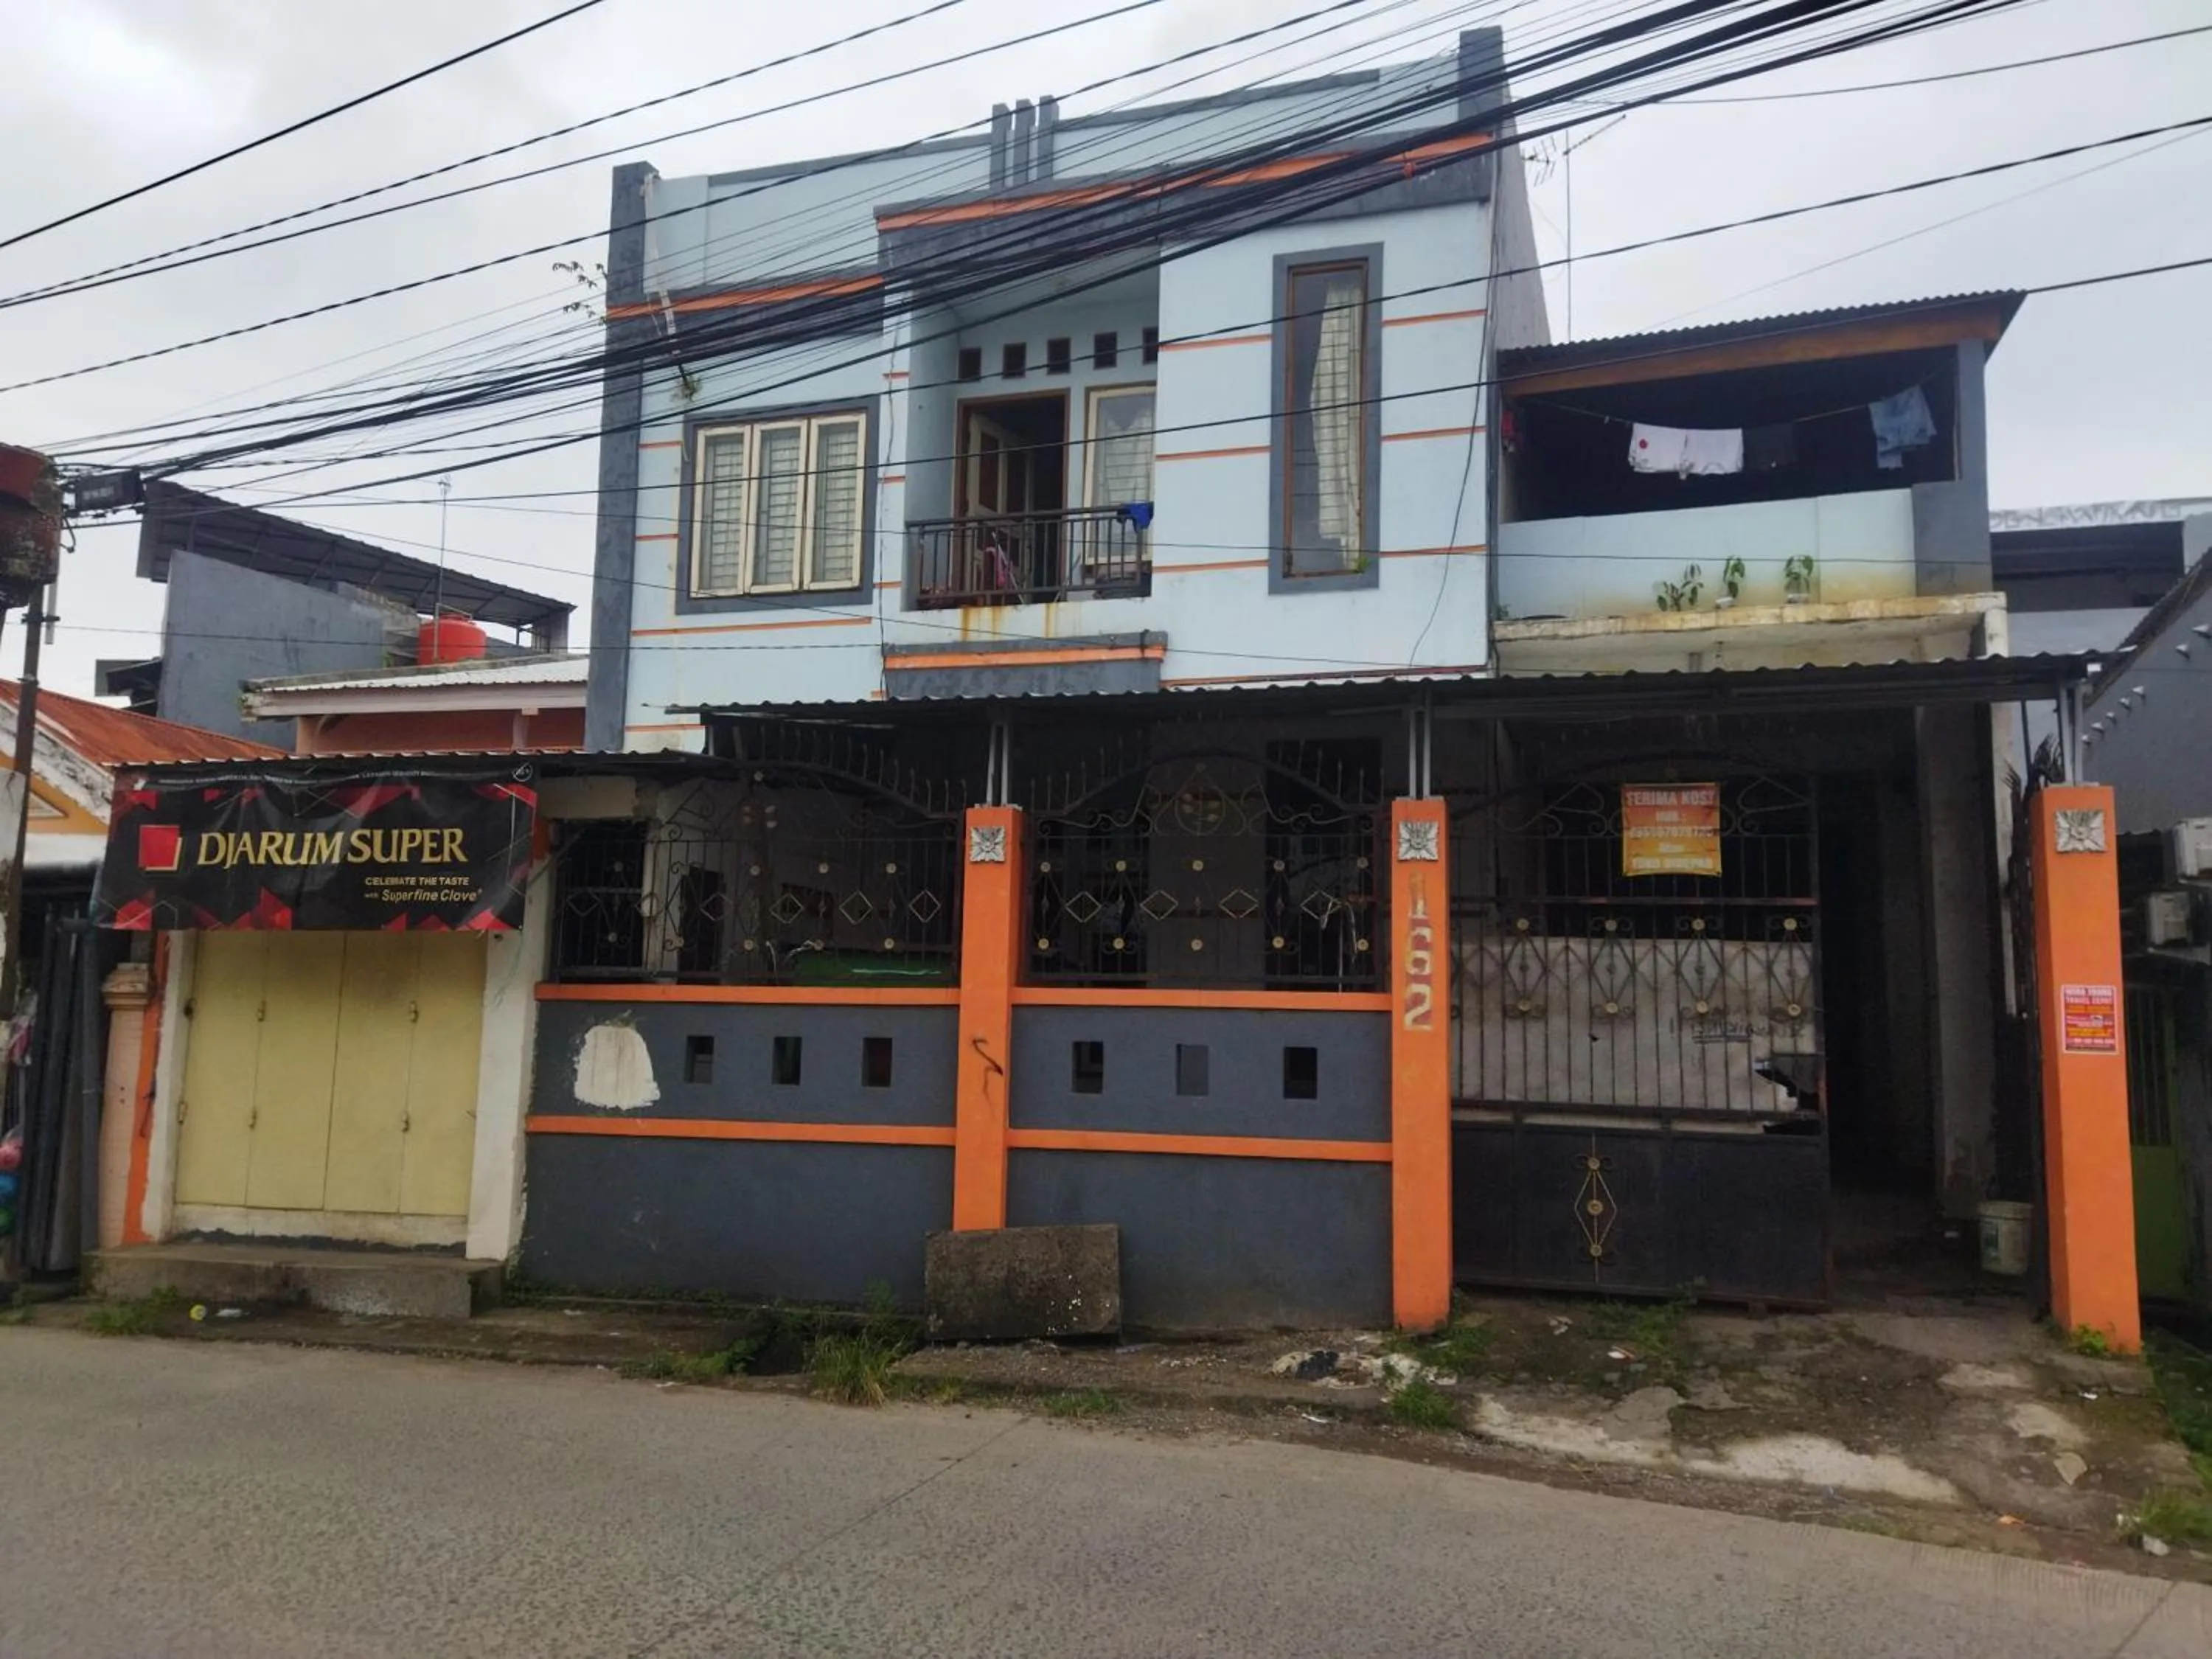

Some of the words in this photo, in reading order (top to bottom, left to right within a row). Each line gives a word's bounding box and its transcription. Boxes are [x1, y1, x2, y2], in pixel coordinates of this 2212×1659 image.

[197, 831, 344, 869] DJARUM
[347, 828, 469, 863] SUPER
[419, 877, 437, 886] THE
[439, 877, 470, 886] TASTE
[381, 888, 439, 903] Superfine
